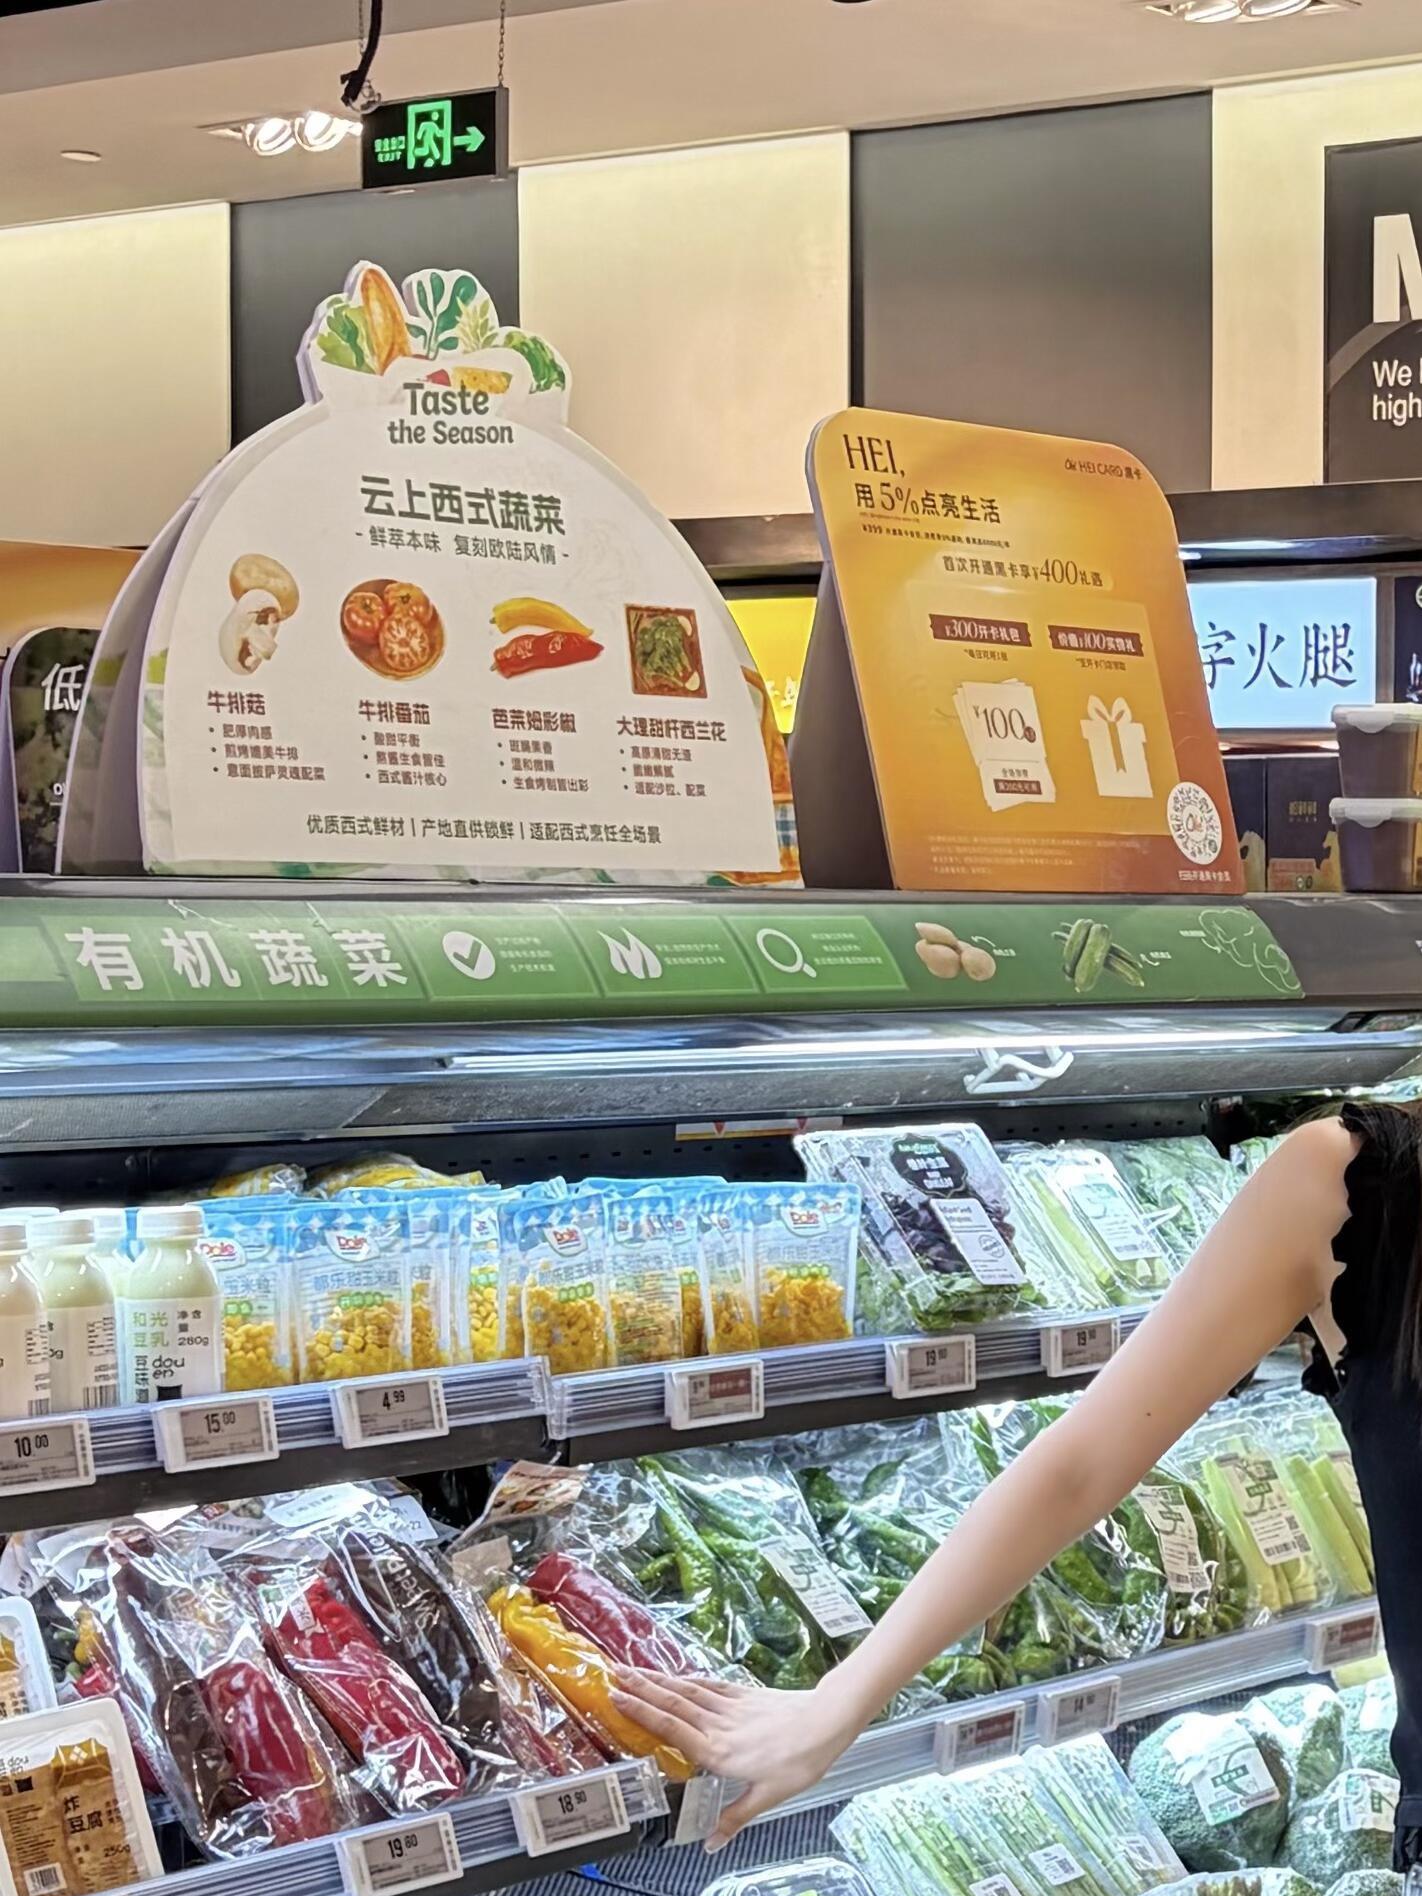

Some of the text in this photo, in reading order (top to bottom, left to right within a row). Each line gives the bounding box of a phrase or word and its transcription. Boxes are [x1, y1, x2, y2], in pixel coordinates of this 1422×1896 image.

[1372, 359, 1414, 388] We
[403, 382, 490, 417] Taste
[388, 419, 514, 446] the Season
[843, 434, 905, 478] HEI,
[360, 475, 566, 536] 云上西式蔬菜
[454, 534, 556, 565] 复刻欧陆风情
[207, 690, 266, 716] 牛排菇
[358, 700, 430, 725] 牛排番茄
[617, 716, 726, 742] 大理甜杆西兰花
[65, 925, 409, 992] 有机蔬菜
[153, 1356, 185, 1369] dou
[14, 1434, 49, 1458] 10.00
[63, 1795, 80, 1814] 炸
[67, 1810, 104, 1835] 豆腐
